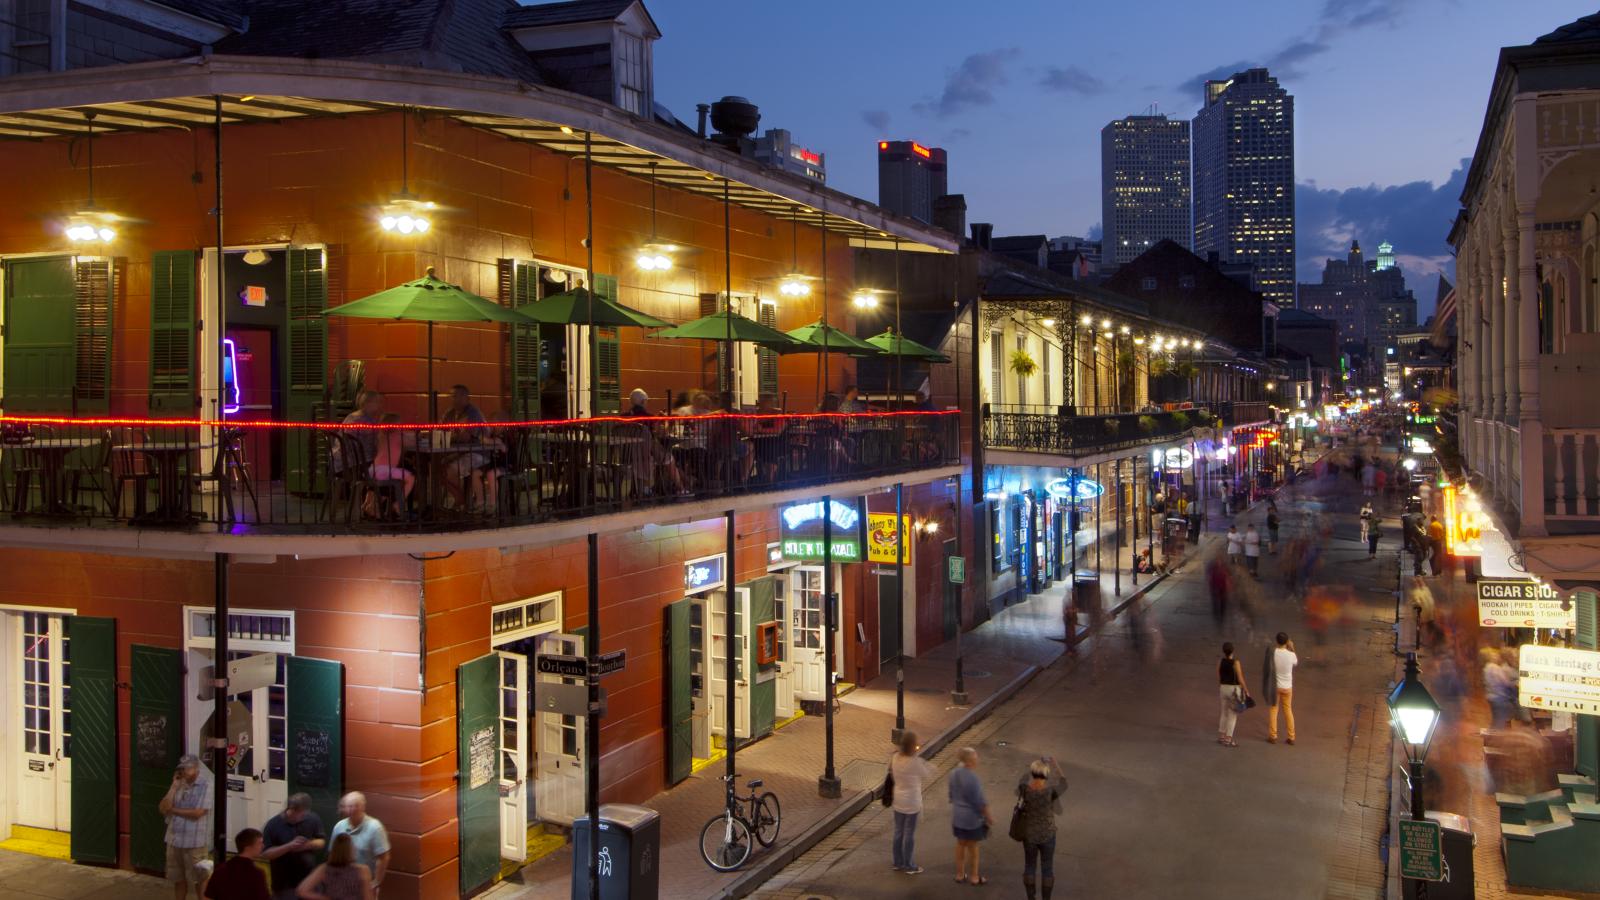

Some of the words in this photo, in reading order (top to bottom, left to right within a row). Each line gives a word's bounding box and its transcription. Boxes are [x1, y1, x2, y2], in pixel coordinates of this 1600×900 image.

[1482, 585, 1522, 598] CIGAR
[1490, 609, 1508, 617] COLD
[1510, 609, 1535, 617] DRINKS
[541, 660, 583, 674] Orleans
[598, 658, 625, 673] Bourbon
[1554, 656, 1592, 672] Heritage
